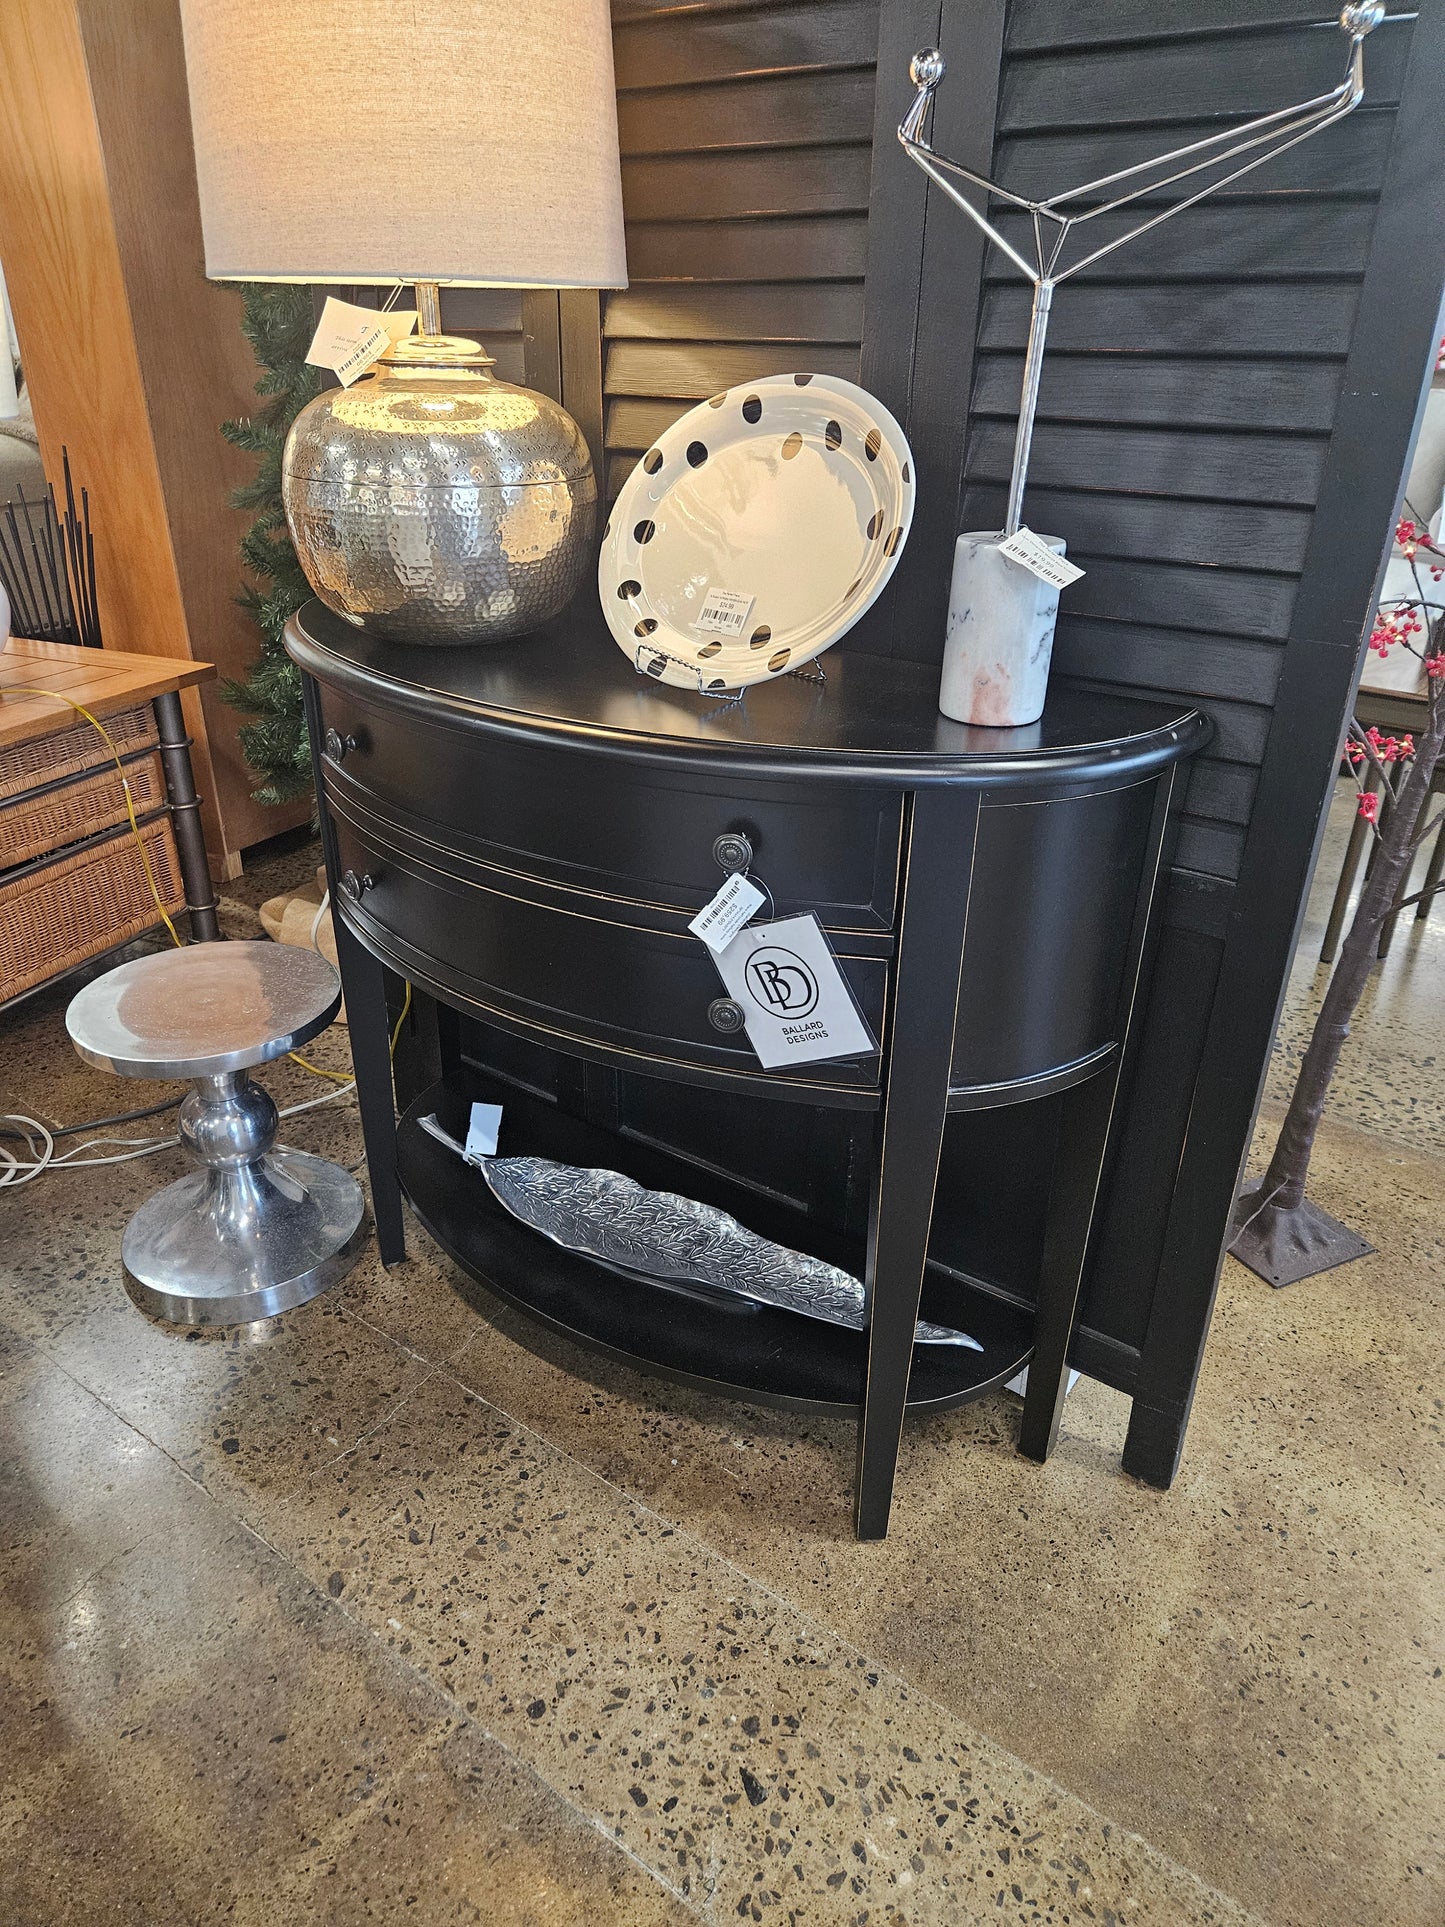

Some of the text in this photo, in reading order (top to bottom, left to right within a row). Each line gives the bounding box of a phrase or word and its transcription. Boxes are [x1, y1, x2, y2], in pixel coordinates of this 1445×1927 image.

[718, 902, 738, 926] $259.99
[782, 1021, 824, 1035] BALLARD
[786, 1030, 828, 1044] DESIGNS
